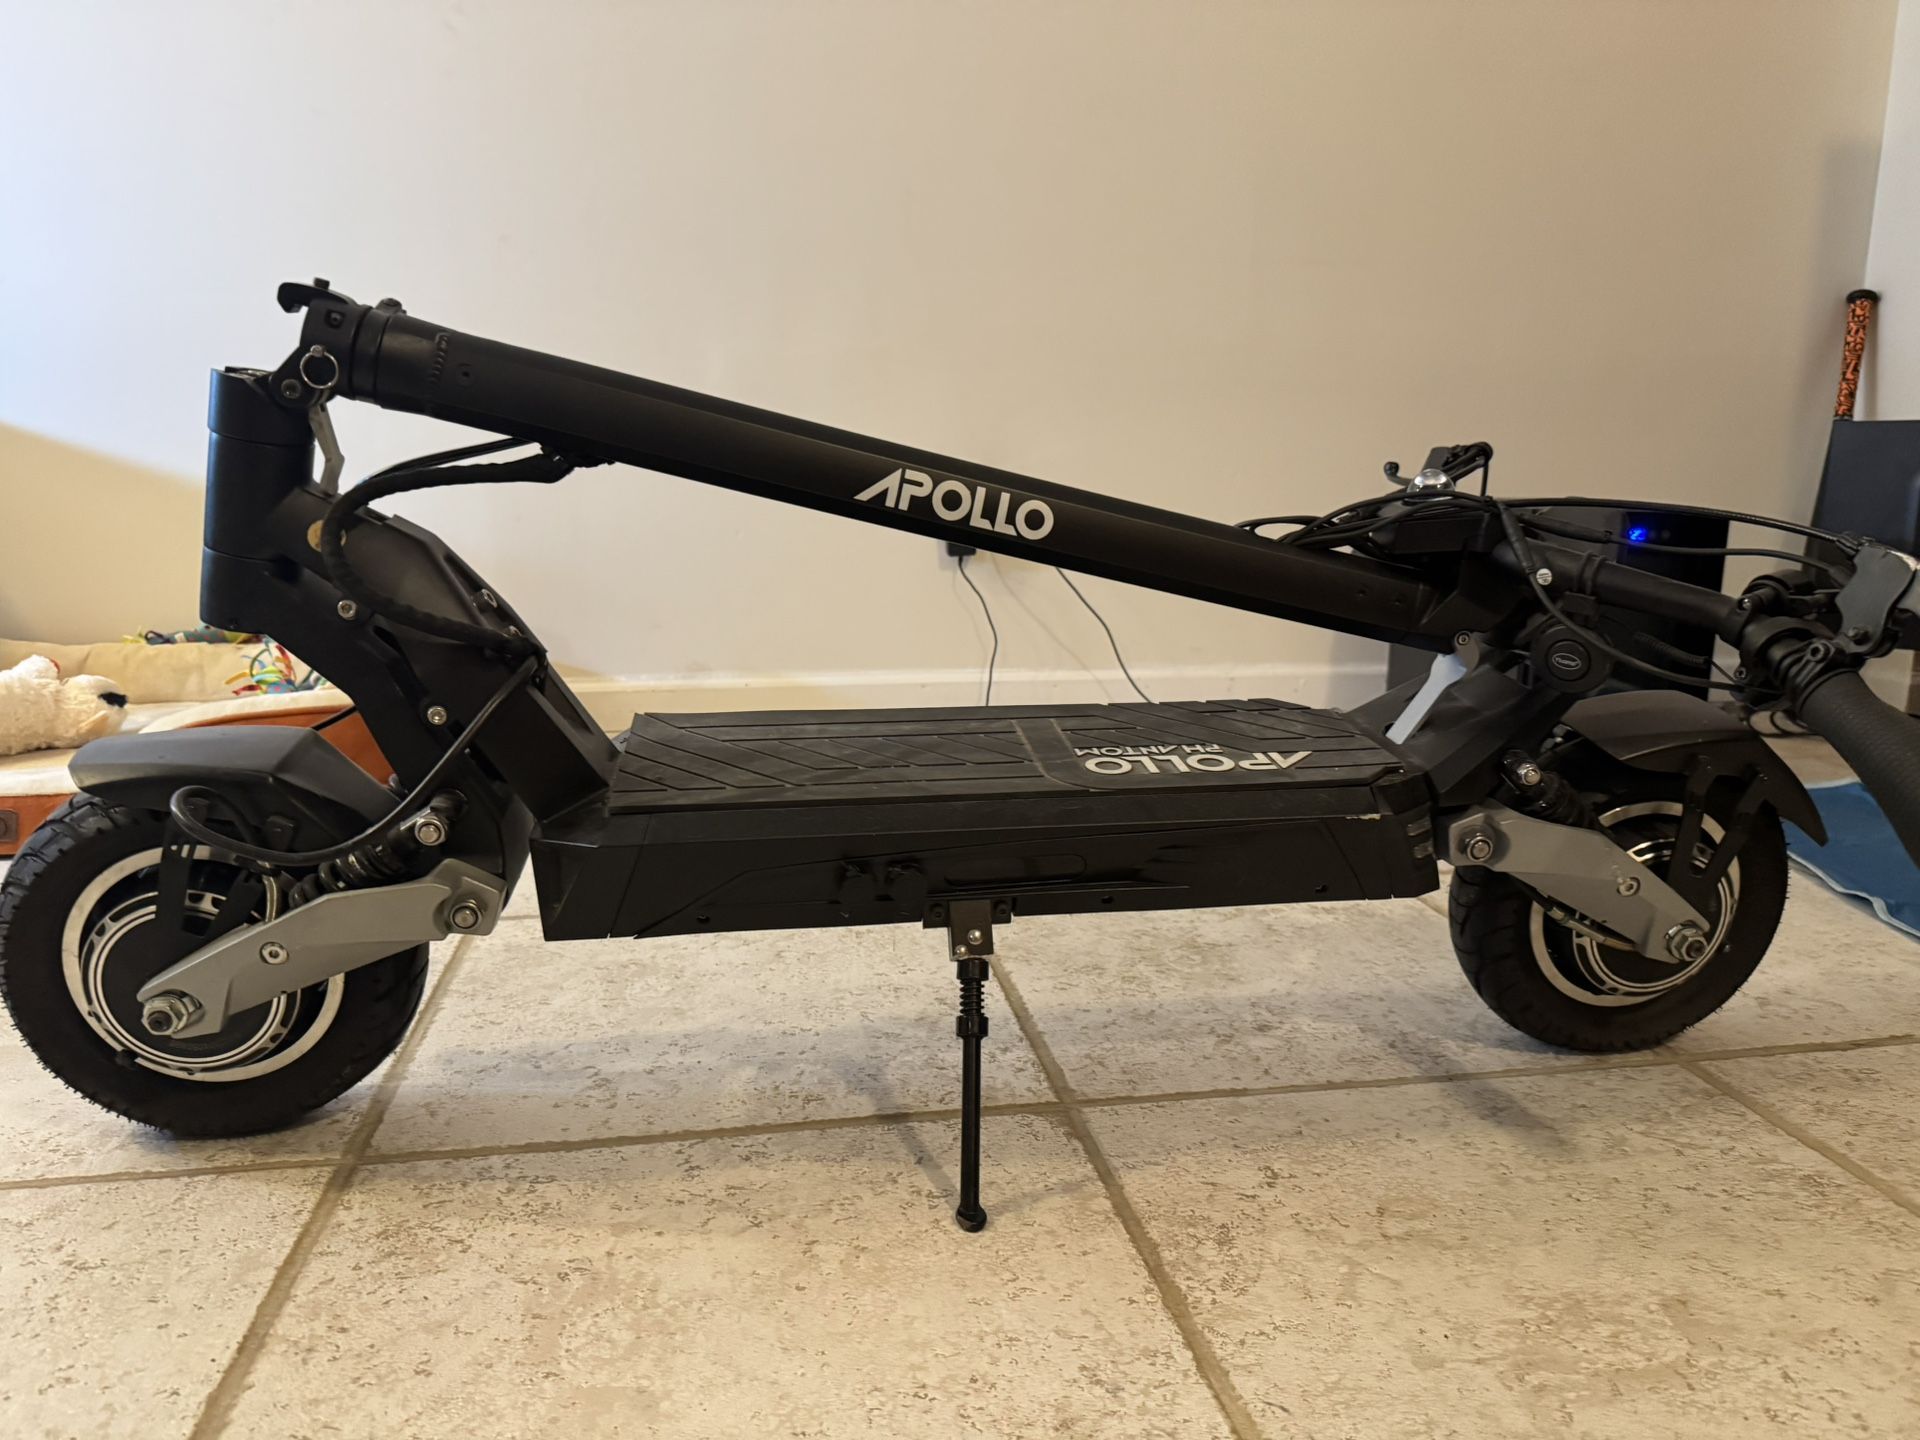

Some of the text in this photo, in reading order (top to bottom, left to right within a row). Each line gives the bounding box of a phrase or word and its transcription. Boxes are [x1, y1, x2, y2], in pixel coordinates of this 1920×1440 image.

[853, 468, 1055, 541] APOLLO
[1074, 744, 1224, 756] PHANTOM
[1084, 751, 1312, 775] APOLLO
